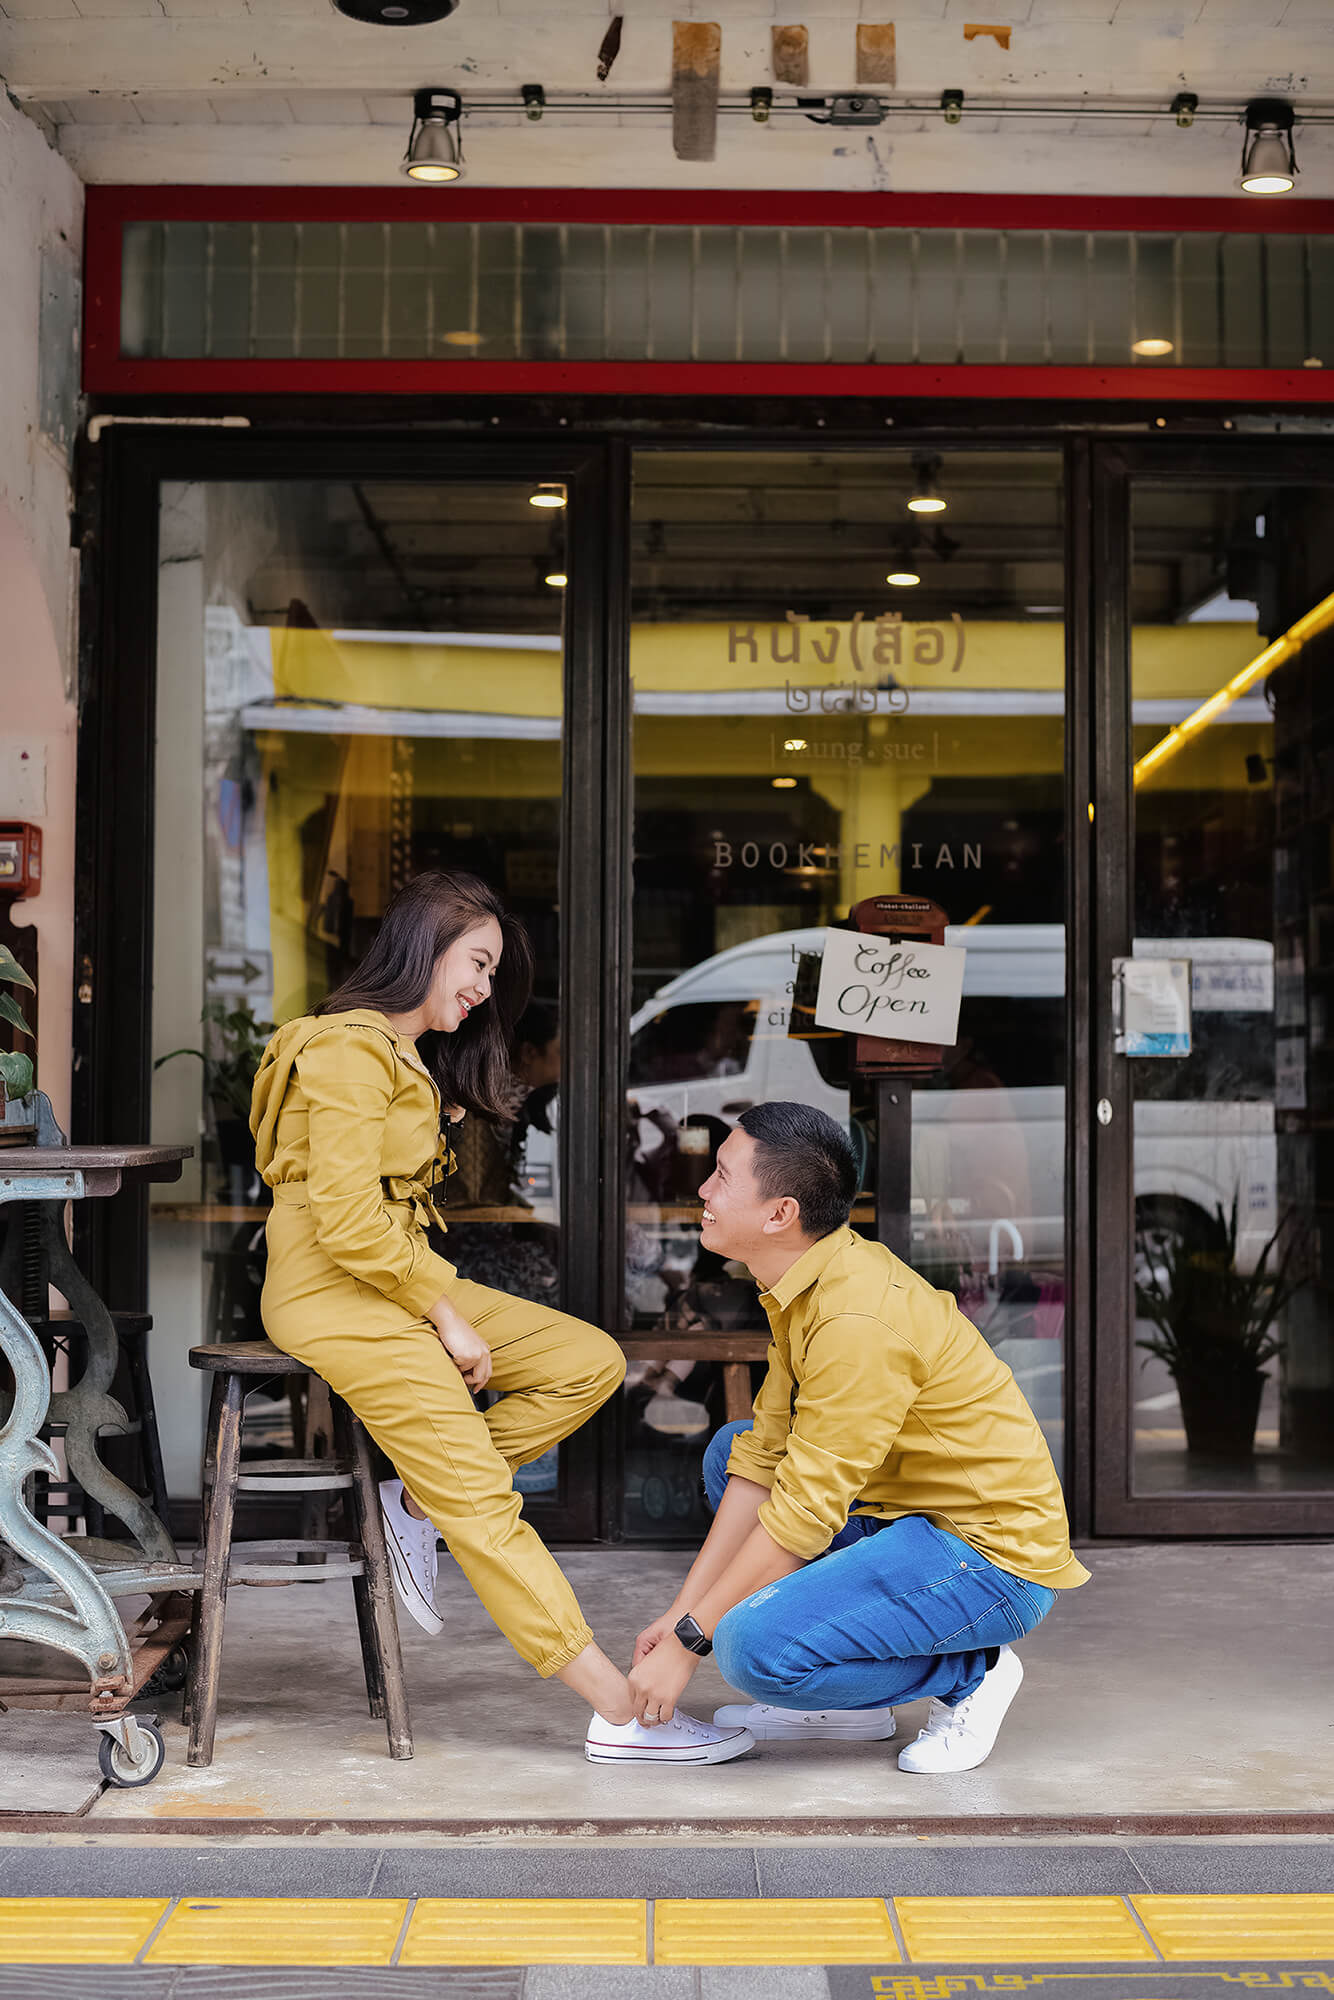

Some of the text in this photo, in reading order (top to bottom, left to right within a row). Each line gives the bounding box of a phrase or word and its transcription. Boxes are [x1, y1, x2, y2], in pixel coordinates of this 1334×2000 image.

[713, 842, 982, 869] BOOKHEMIAN
[854, 943, 931, 990] Coffee
[837, 984, 930, 1023] Open
